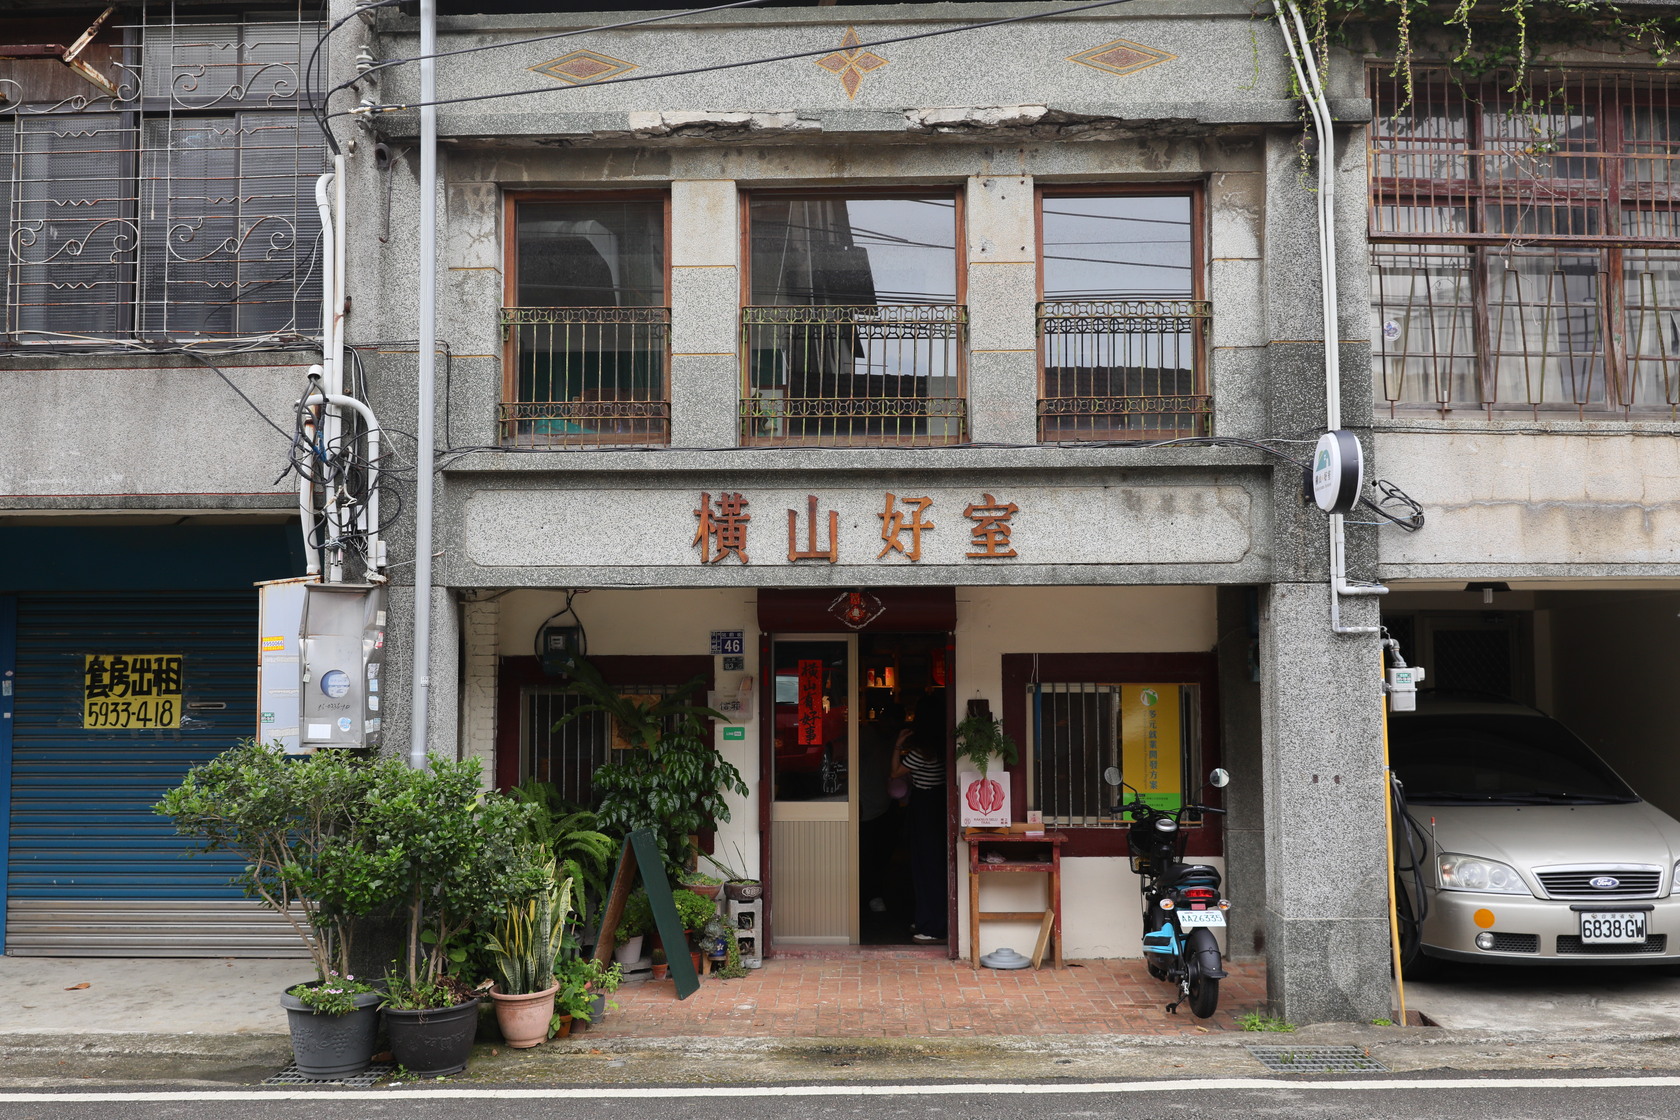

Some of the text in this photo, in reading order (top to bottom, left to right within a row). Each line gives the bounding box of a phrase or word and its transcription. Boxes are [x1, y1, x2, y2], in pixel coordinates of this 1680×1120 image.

[692, 491, 1018, 564] 橫山好室
[724, 640, 740, 652] 46
[85, 656, 181, 699] 套房出租
[88, 700, 173, 727] 5933-418
[1148, 709, 1158, 790] 多元就業開發方案
[1596, 879, 1612, 887] Ford
